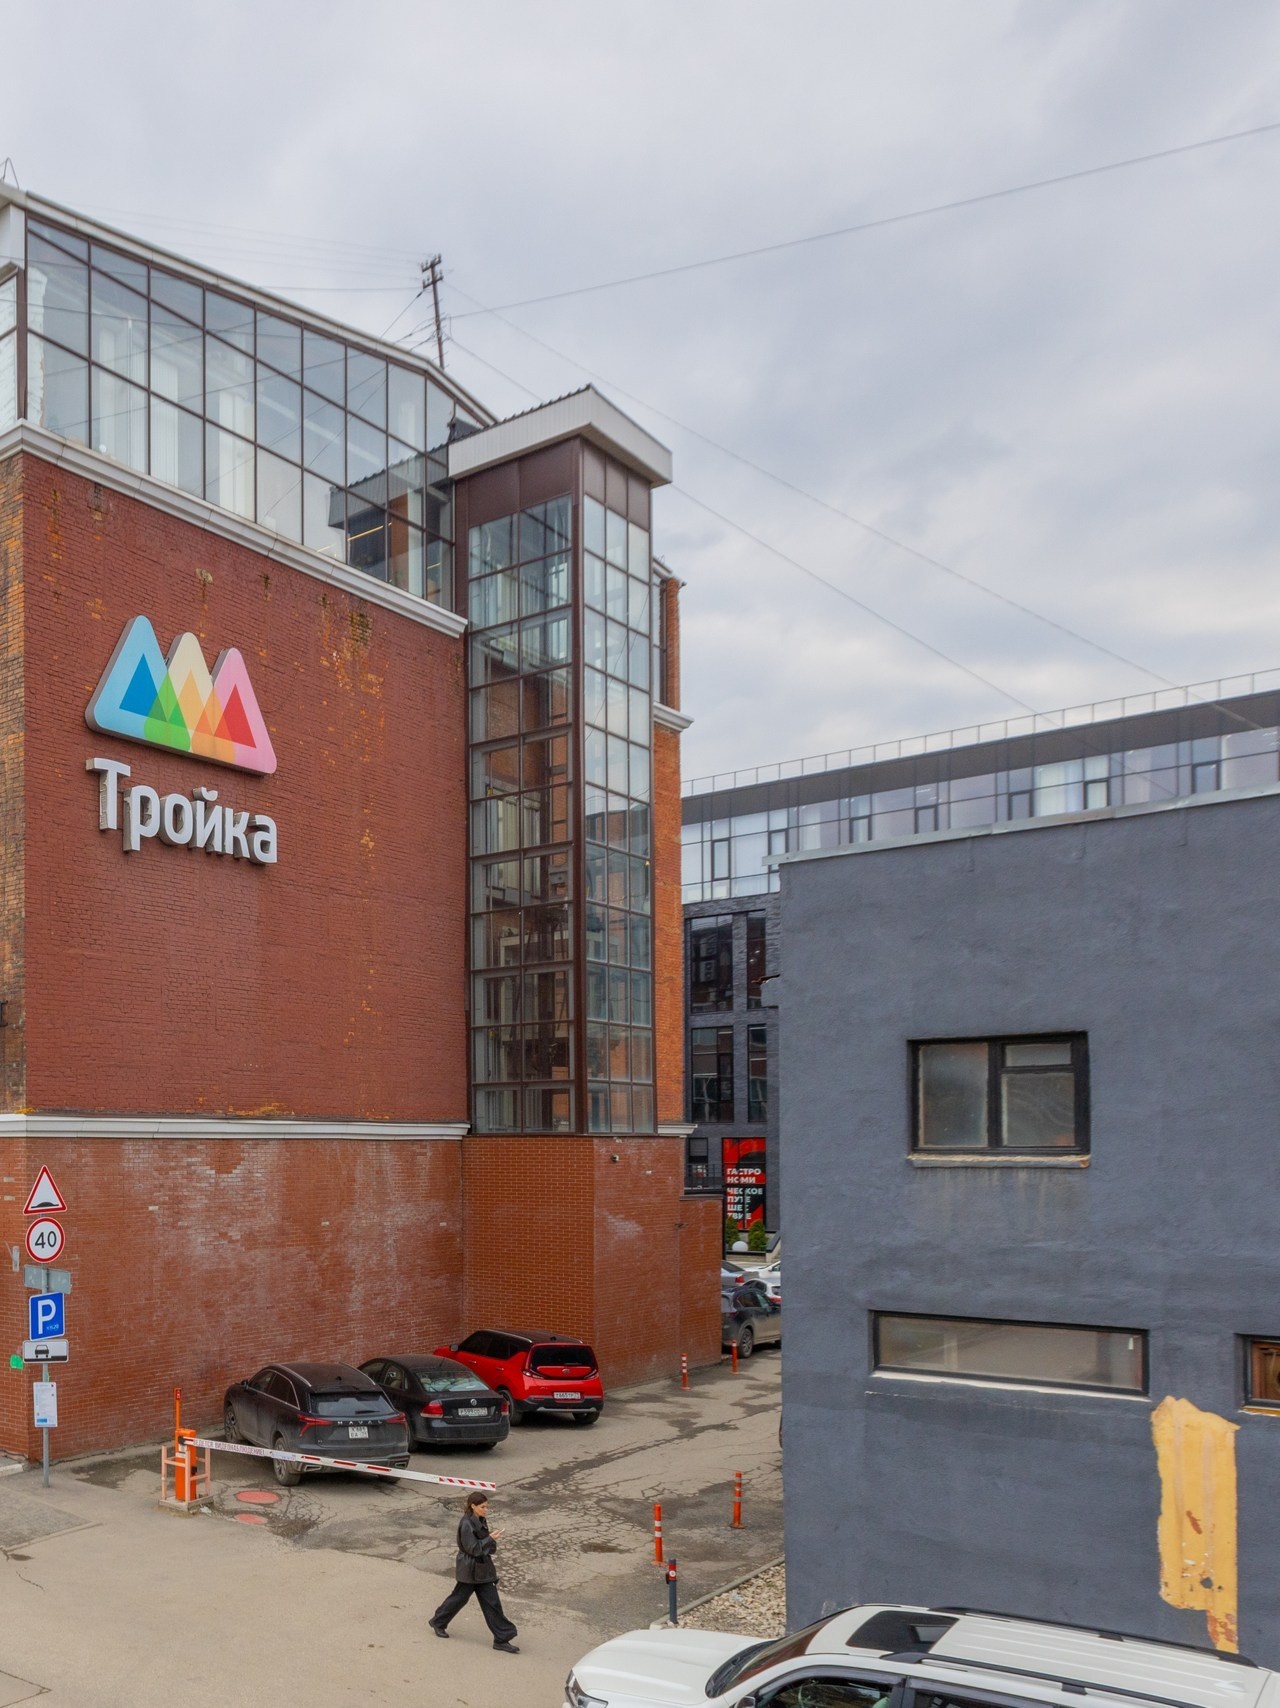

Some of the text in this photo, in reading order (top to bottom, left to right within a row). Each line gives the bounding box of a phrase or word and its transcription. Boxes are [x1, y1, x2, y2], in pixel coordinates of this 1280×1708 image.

[86, 757, 278, 865] Тройка
[726, 1187, 763, 1195] ЧЕСКОЕ
[34, 1230, 57, 1249] 40
[37, 1299, 57, 1335] P
